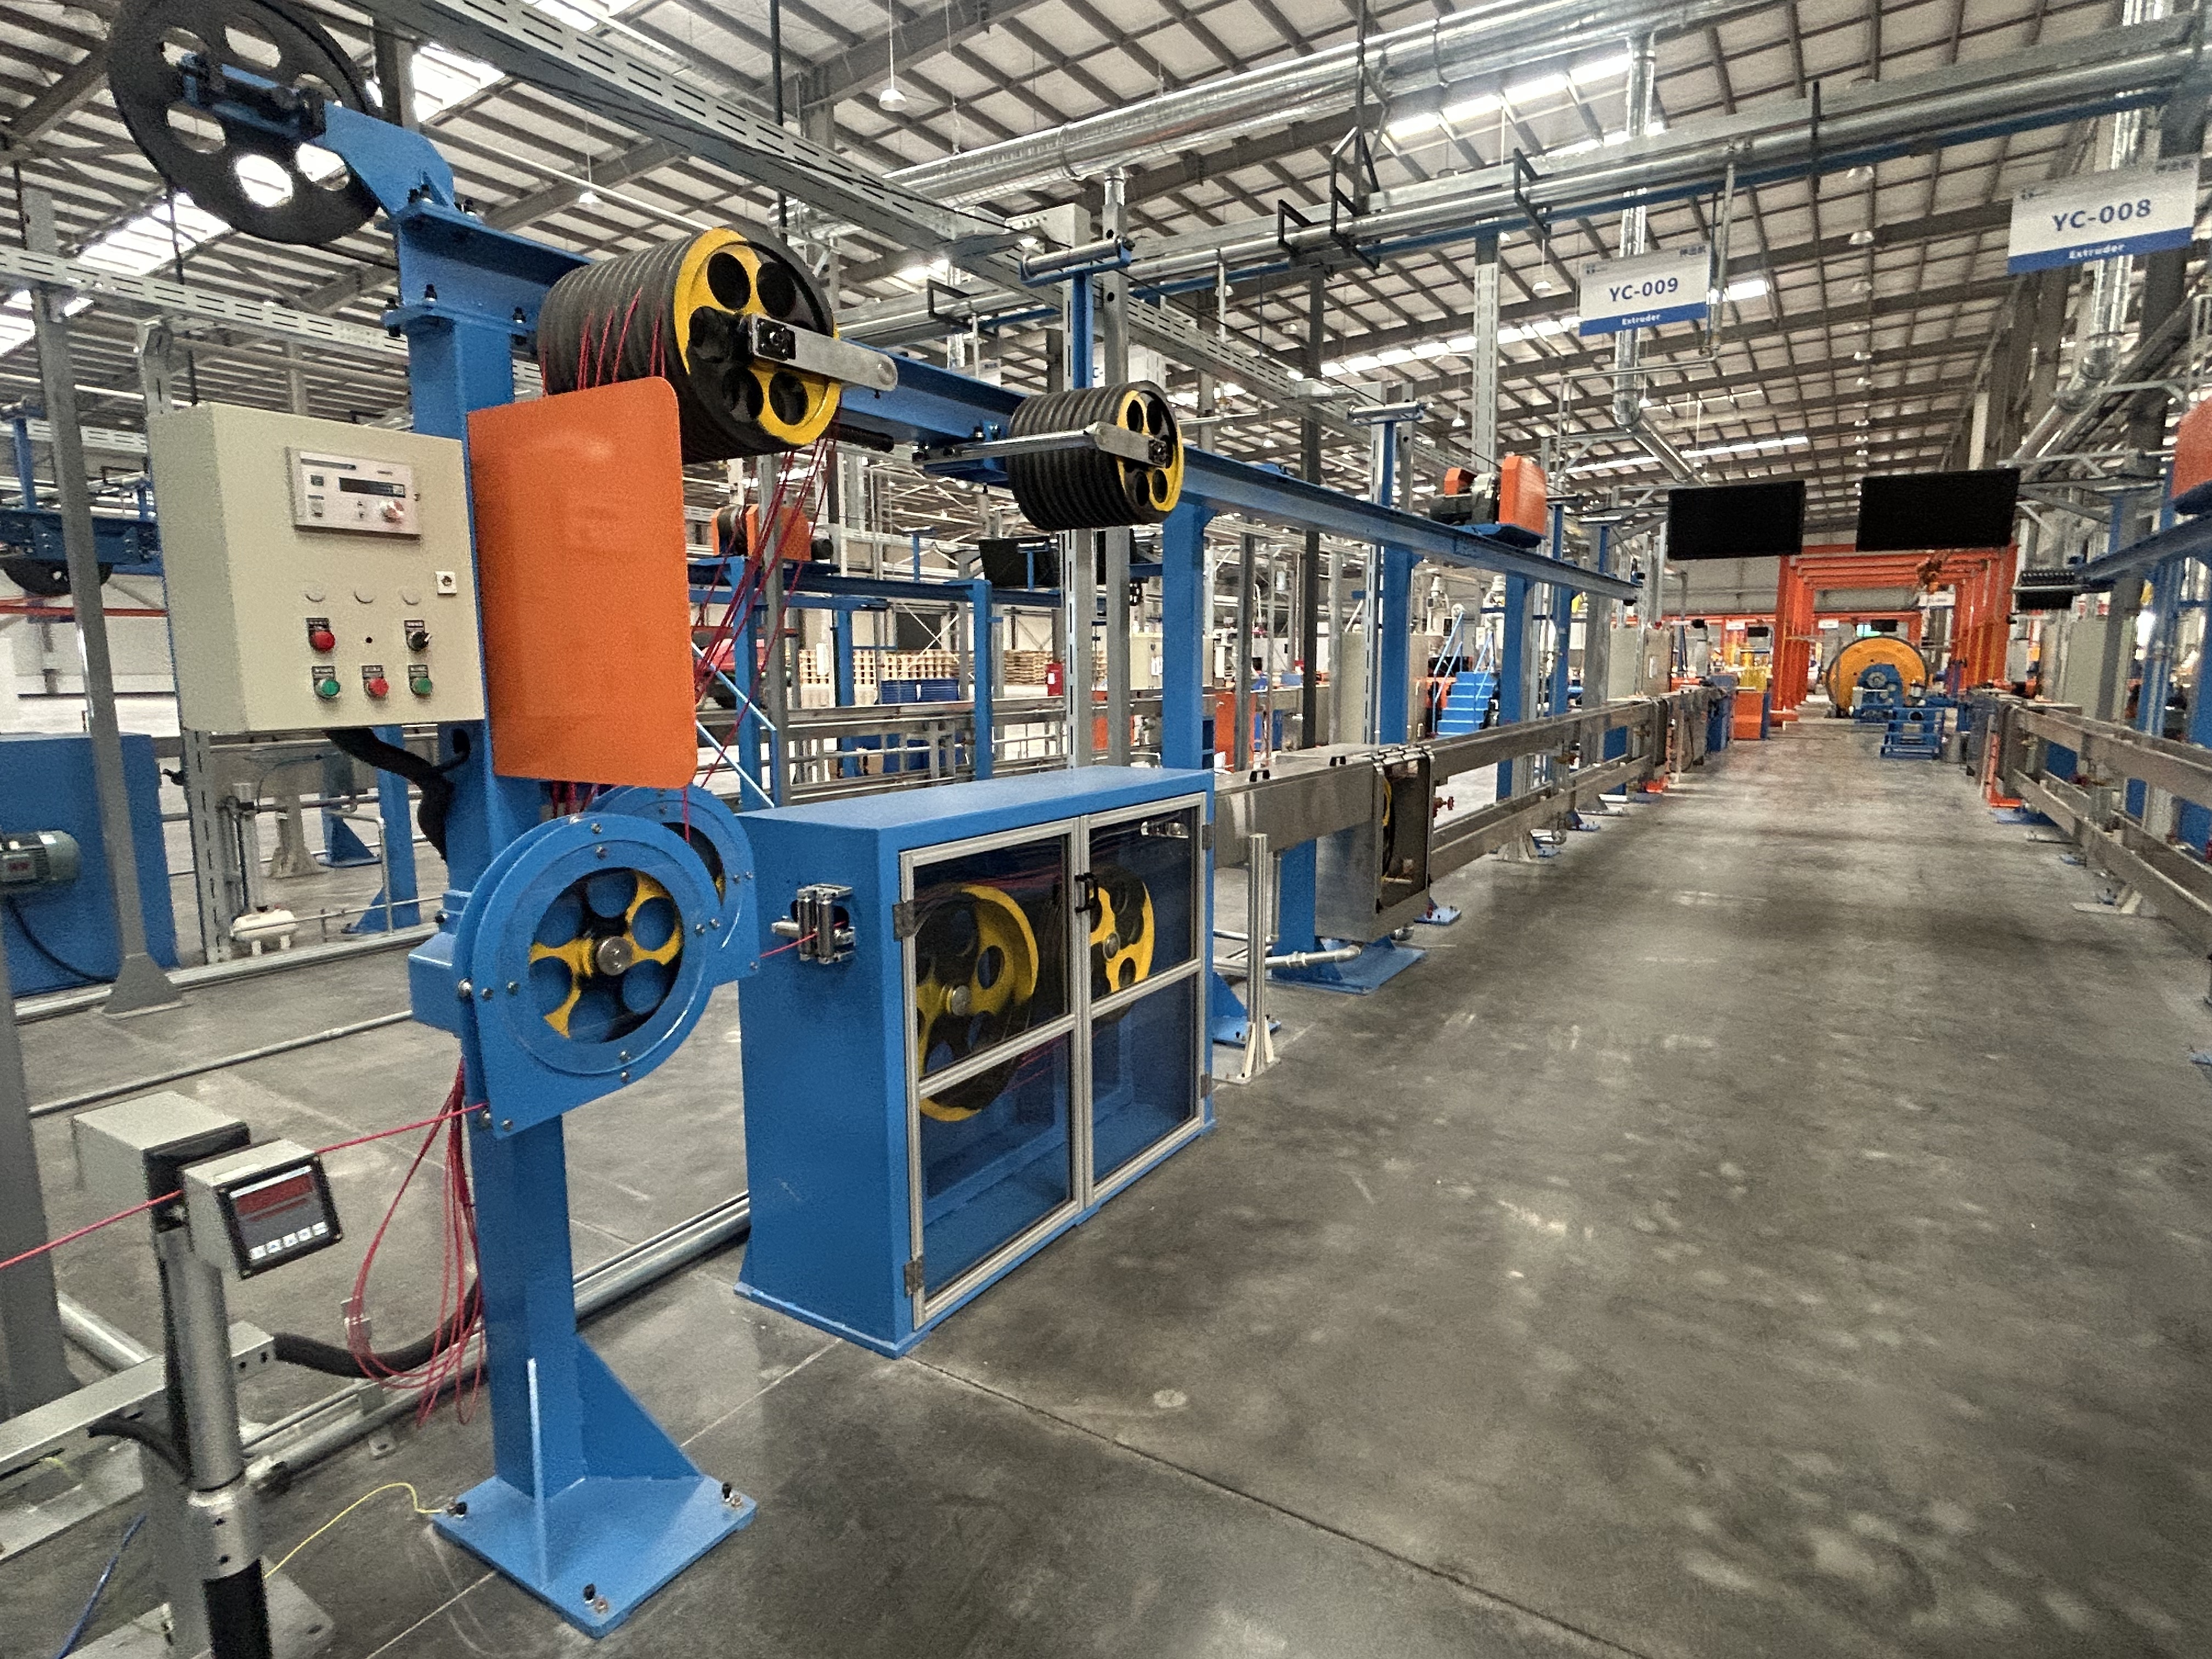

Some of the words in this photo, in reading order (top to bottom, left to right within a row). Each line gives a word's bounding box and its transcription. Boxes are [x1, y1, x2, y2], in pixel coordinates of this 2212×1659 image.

[2052, 199, 2151, 232] YC-008
[2069, 244, 2125, 259] Extruder
[1609, 278, 1678, 302] YC-009
[1622, 313, 1661, 326] Extruder
